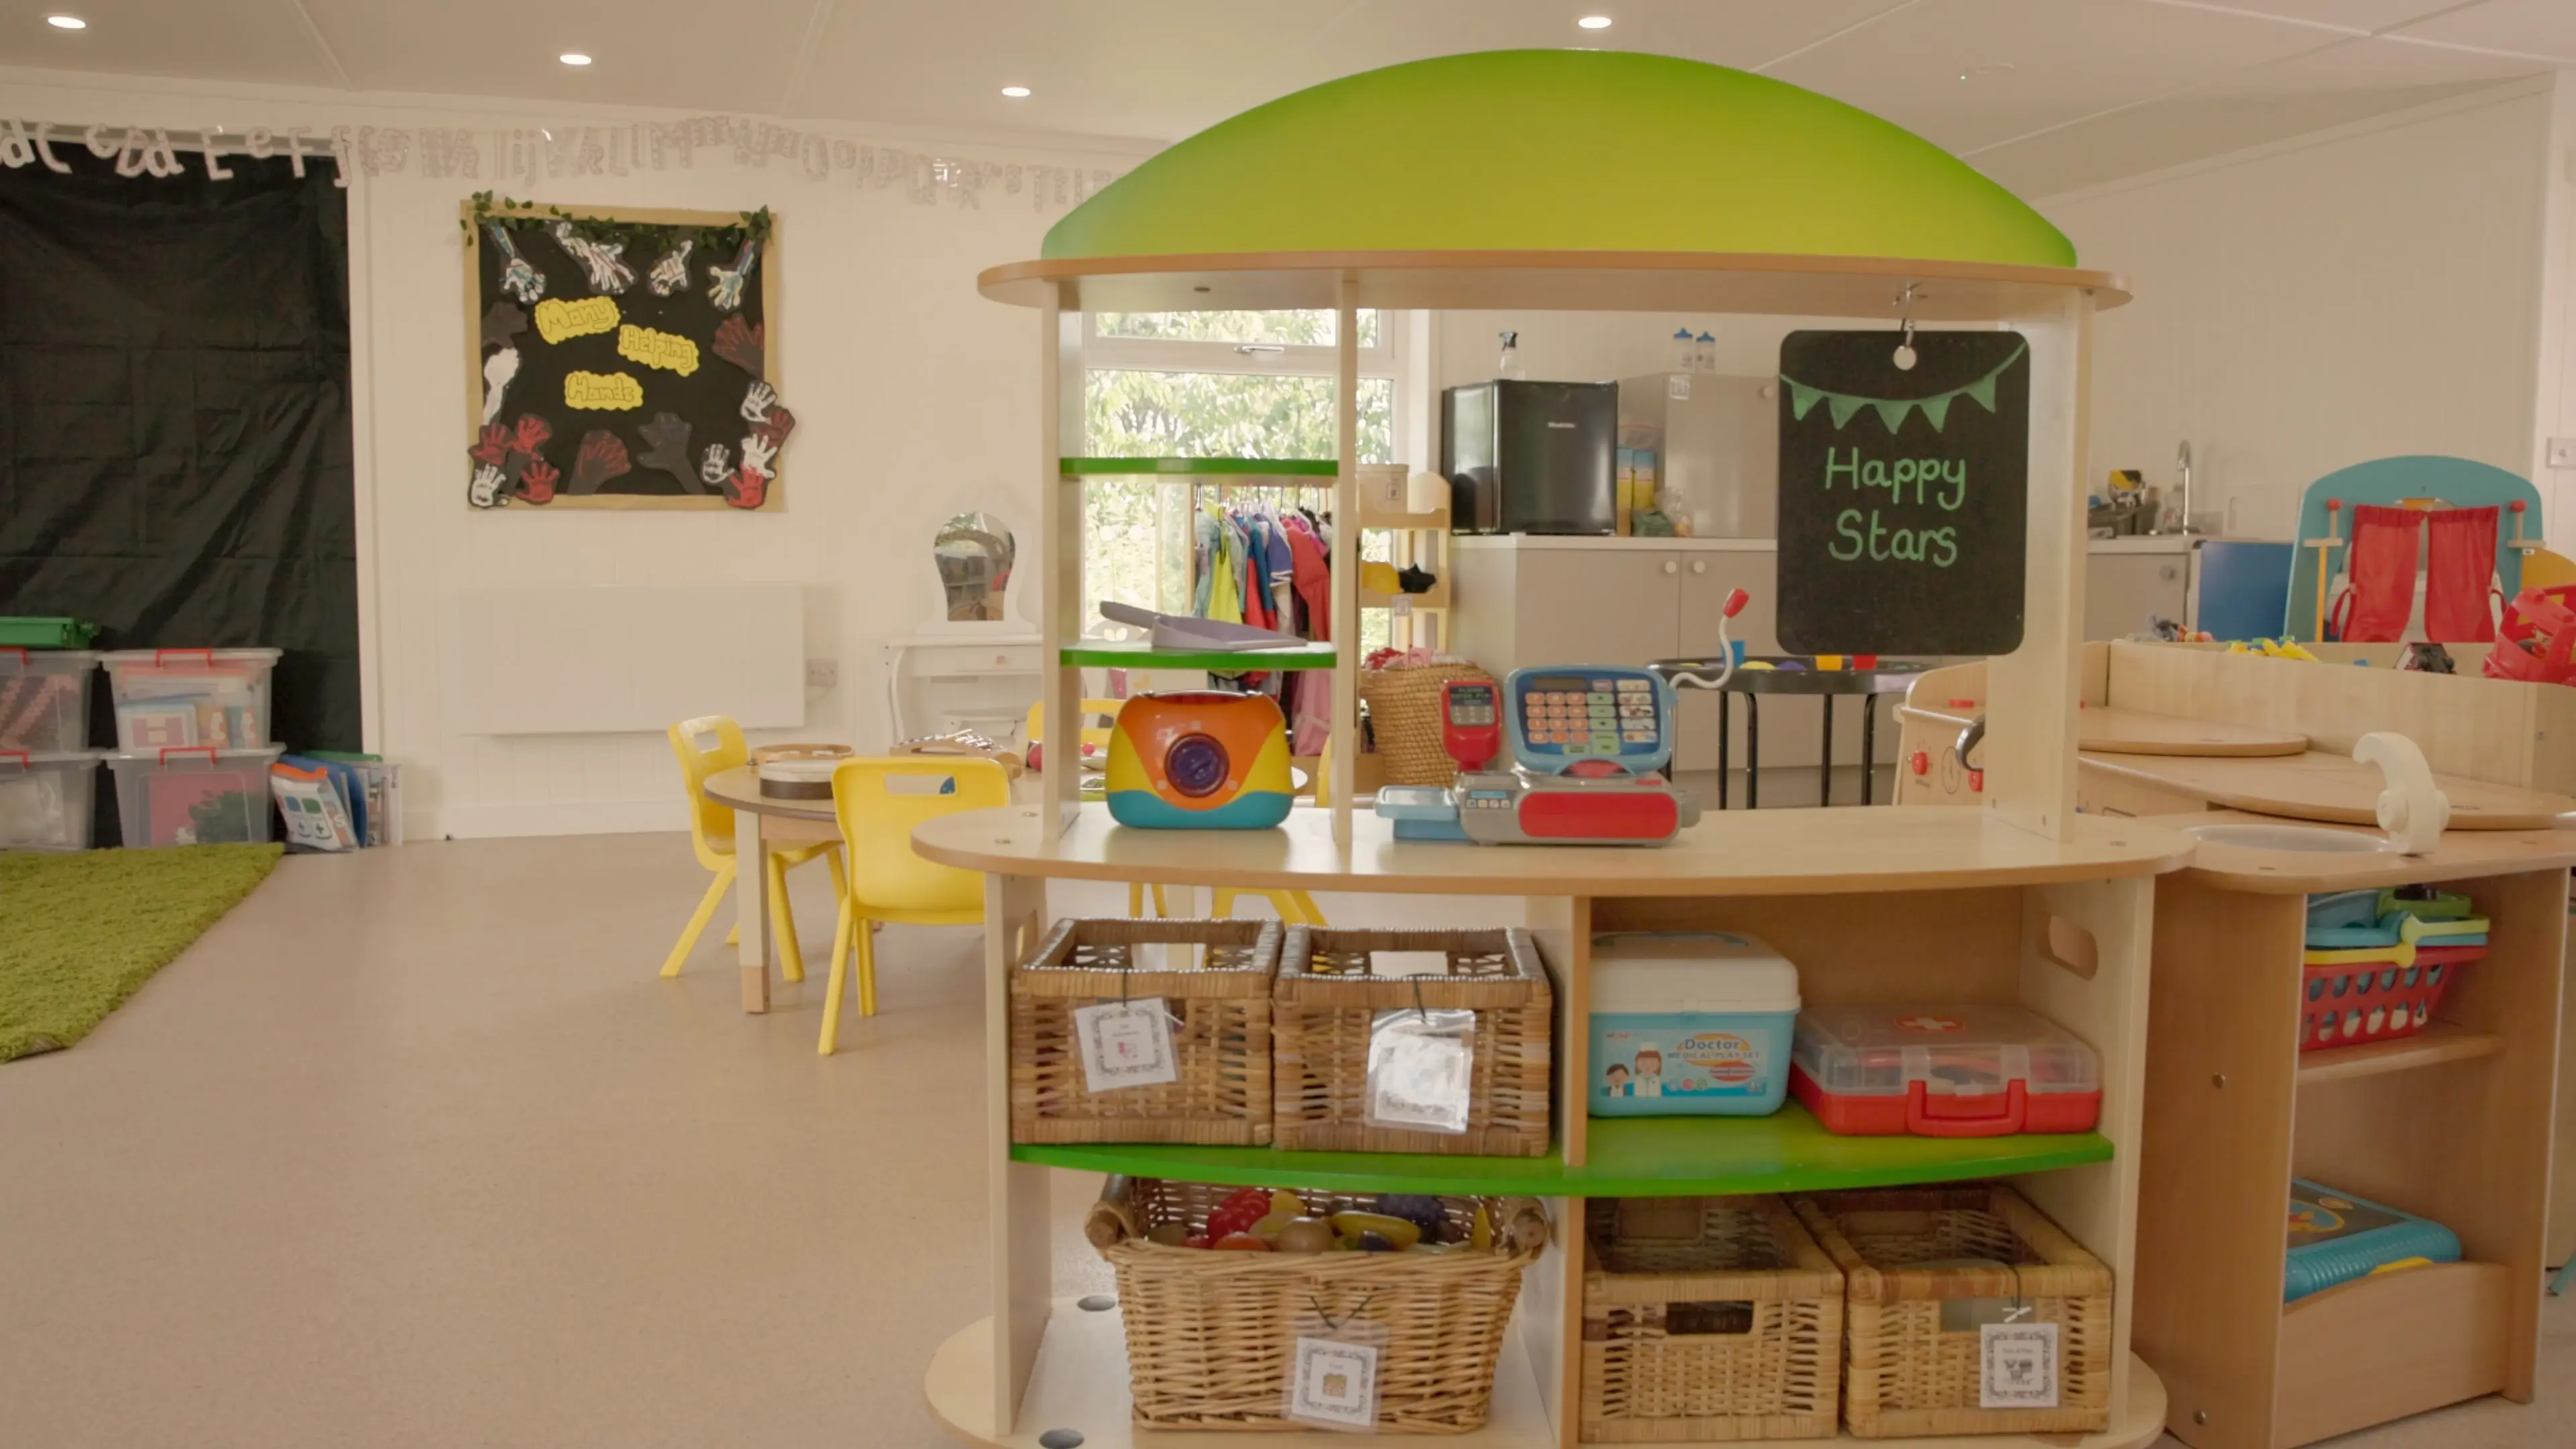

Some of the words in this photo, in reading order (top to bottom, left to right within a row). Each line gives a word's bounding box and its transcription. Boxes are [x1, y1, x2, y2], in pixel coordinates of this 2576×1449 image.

[538, 301, 616, 335] Many
[622, 326, 694, 369] Helping
[568, 374, 635, 402] Hands
[1825, 447, 1967, 511] Happy
[1828, 508, 1958, 568] Stars
[1684, 1038, 1740, 1051] Doctor
